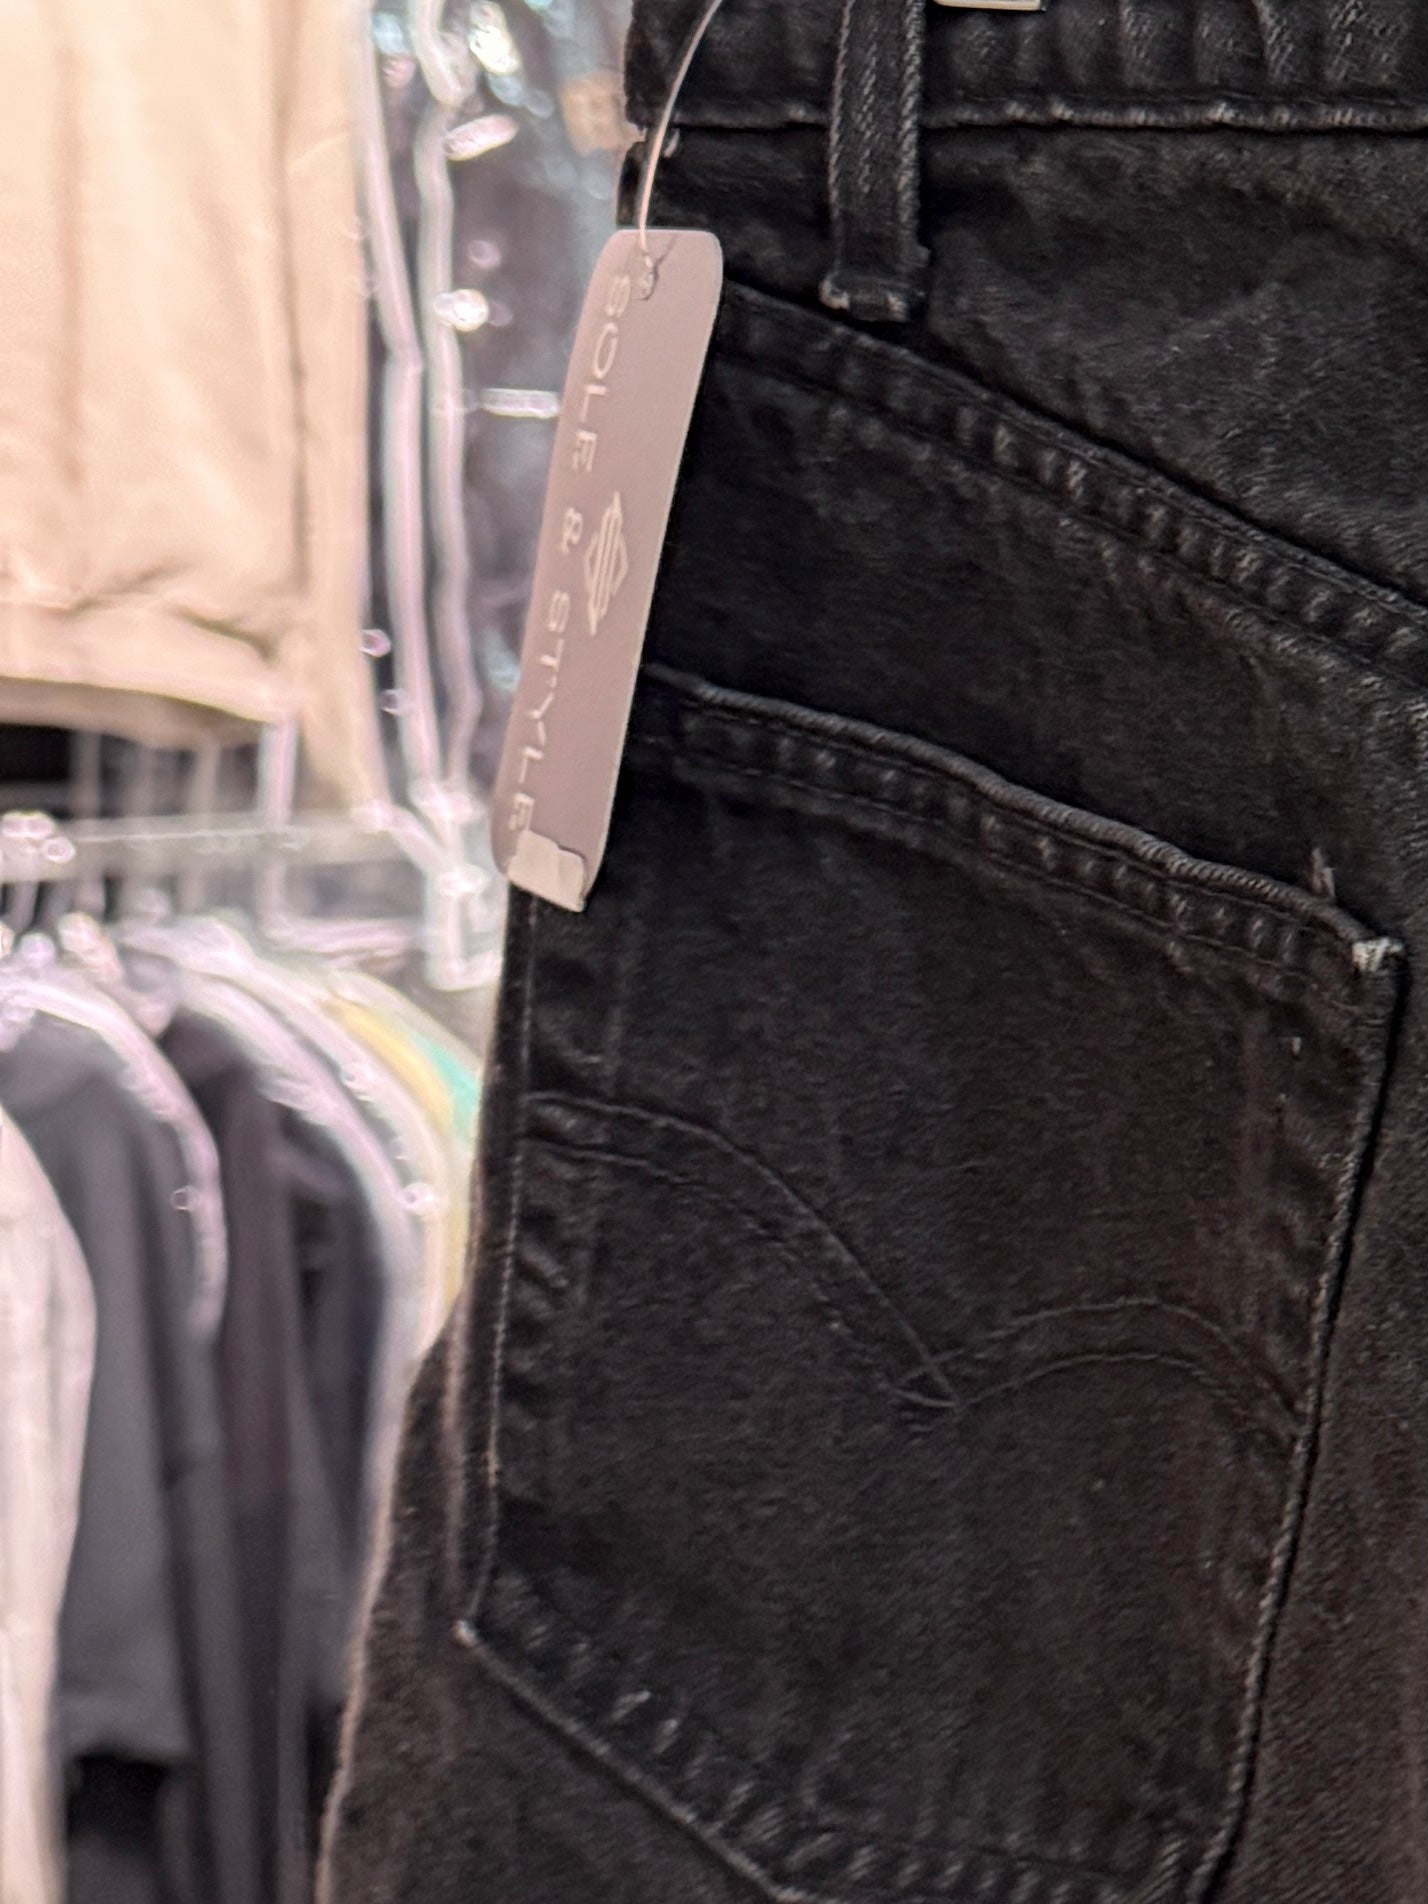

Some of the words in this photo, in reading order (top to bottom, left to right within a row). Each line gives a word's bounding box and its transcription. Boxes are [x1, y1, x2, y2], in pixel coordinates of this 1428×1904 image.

[569, 274, 632, 474] SOLE
[561, 507, 584, 556] &
[507, 589, 572, 832] STYLE
